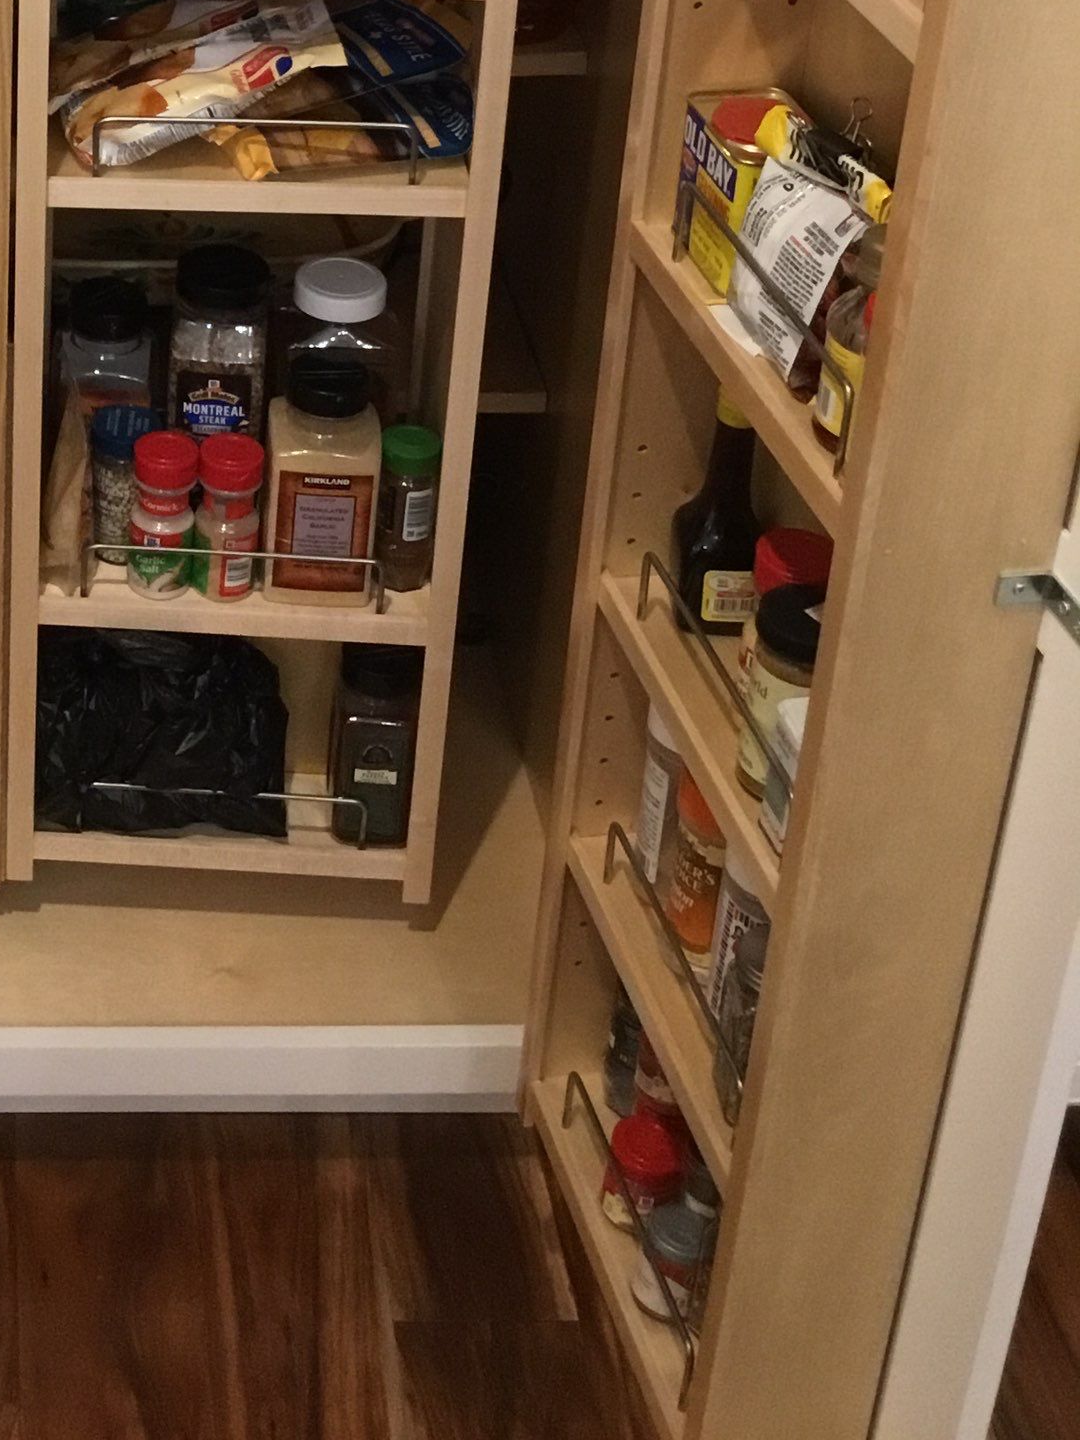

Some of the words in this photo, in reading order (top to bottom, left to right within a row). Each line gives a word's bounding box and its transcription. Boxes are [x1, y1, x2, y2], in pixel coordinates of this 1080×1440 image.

[684, 114, 708, 166] OLD
[706, 142, 734, 198] BAY
[182, 401, 246, 417] MONTREAL
[198, 415, 227, 425] STEAK
[303, 476, 351, 486] KIRKLAND
[143, 498, 180, 512] Cormick
